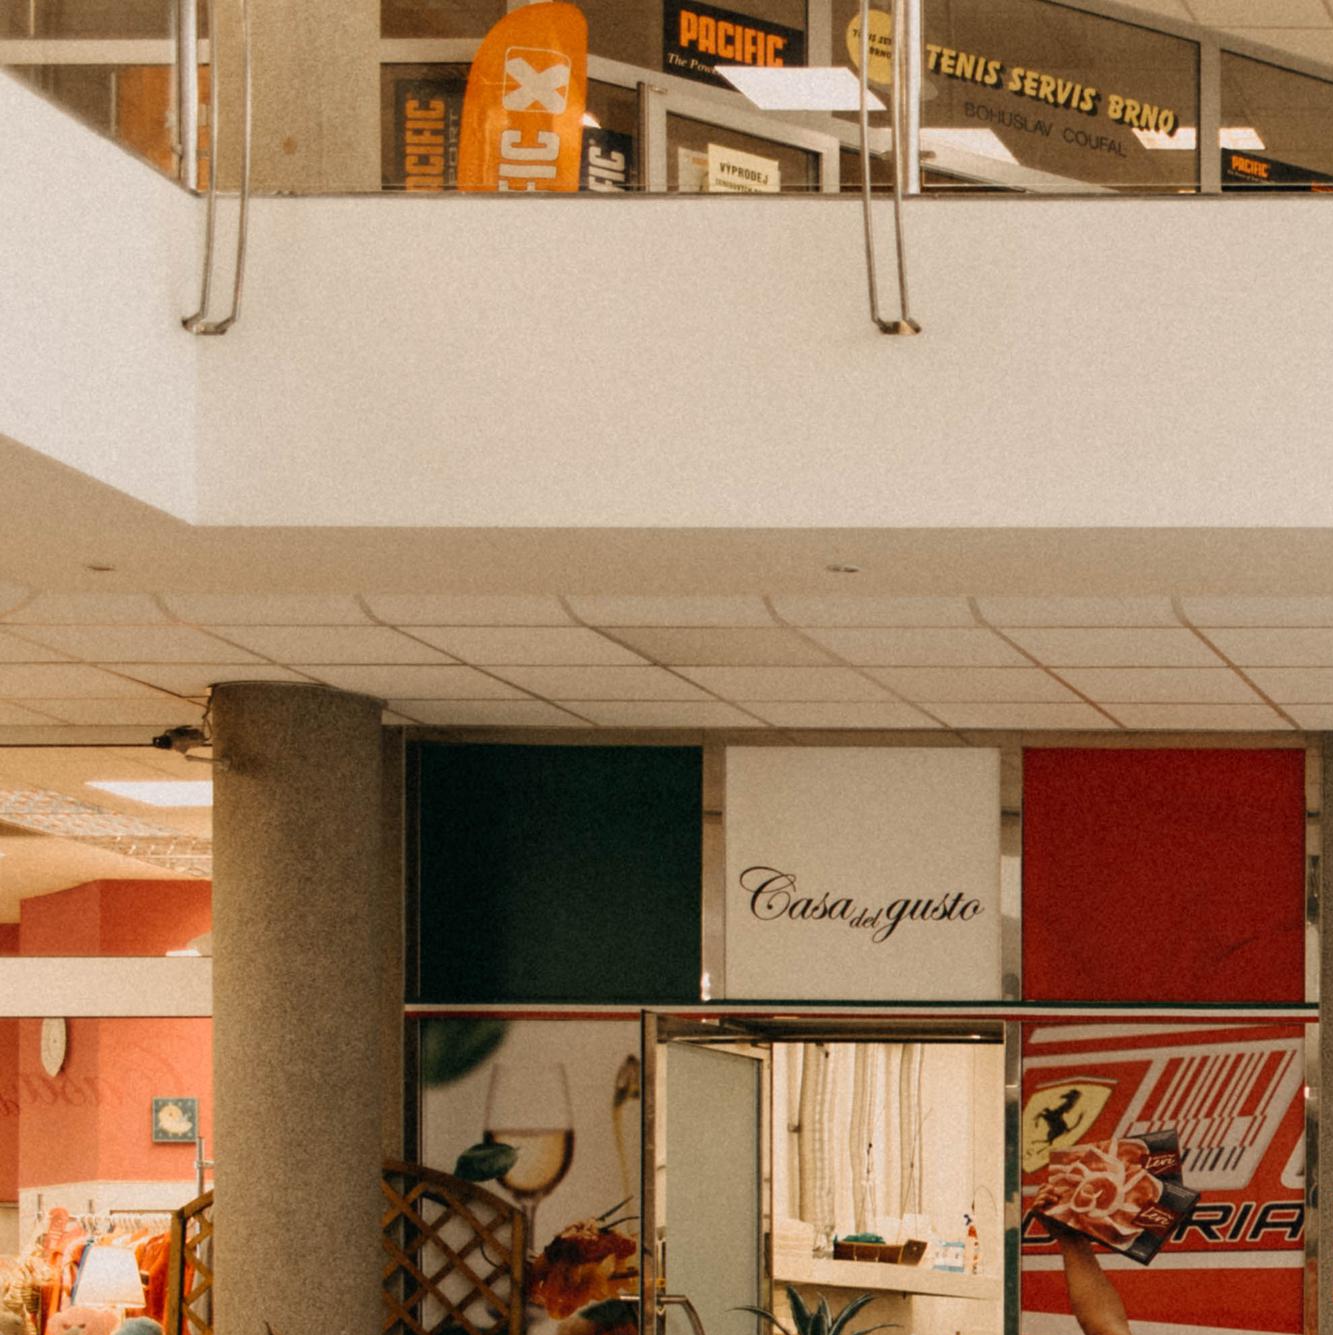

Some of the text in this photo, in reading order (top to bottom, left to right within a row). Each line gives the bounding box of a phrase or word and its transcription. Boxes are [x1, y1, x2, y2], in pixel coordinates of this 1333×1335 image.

[667, 53, 719, 75] The Pow
[679, 9, 785, 68] PACIFIC
[926, 44, 1179, 135] TENIS SERVIS BRNO
[964, 102, 1127, 158] BOHUSLAV COUFAL
[739, 866, 985, 944] Casa del gusto
